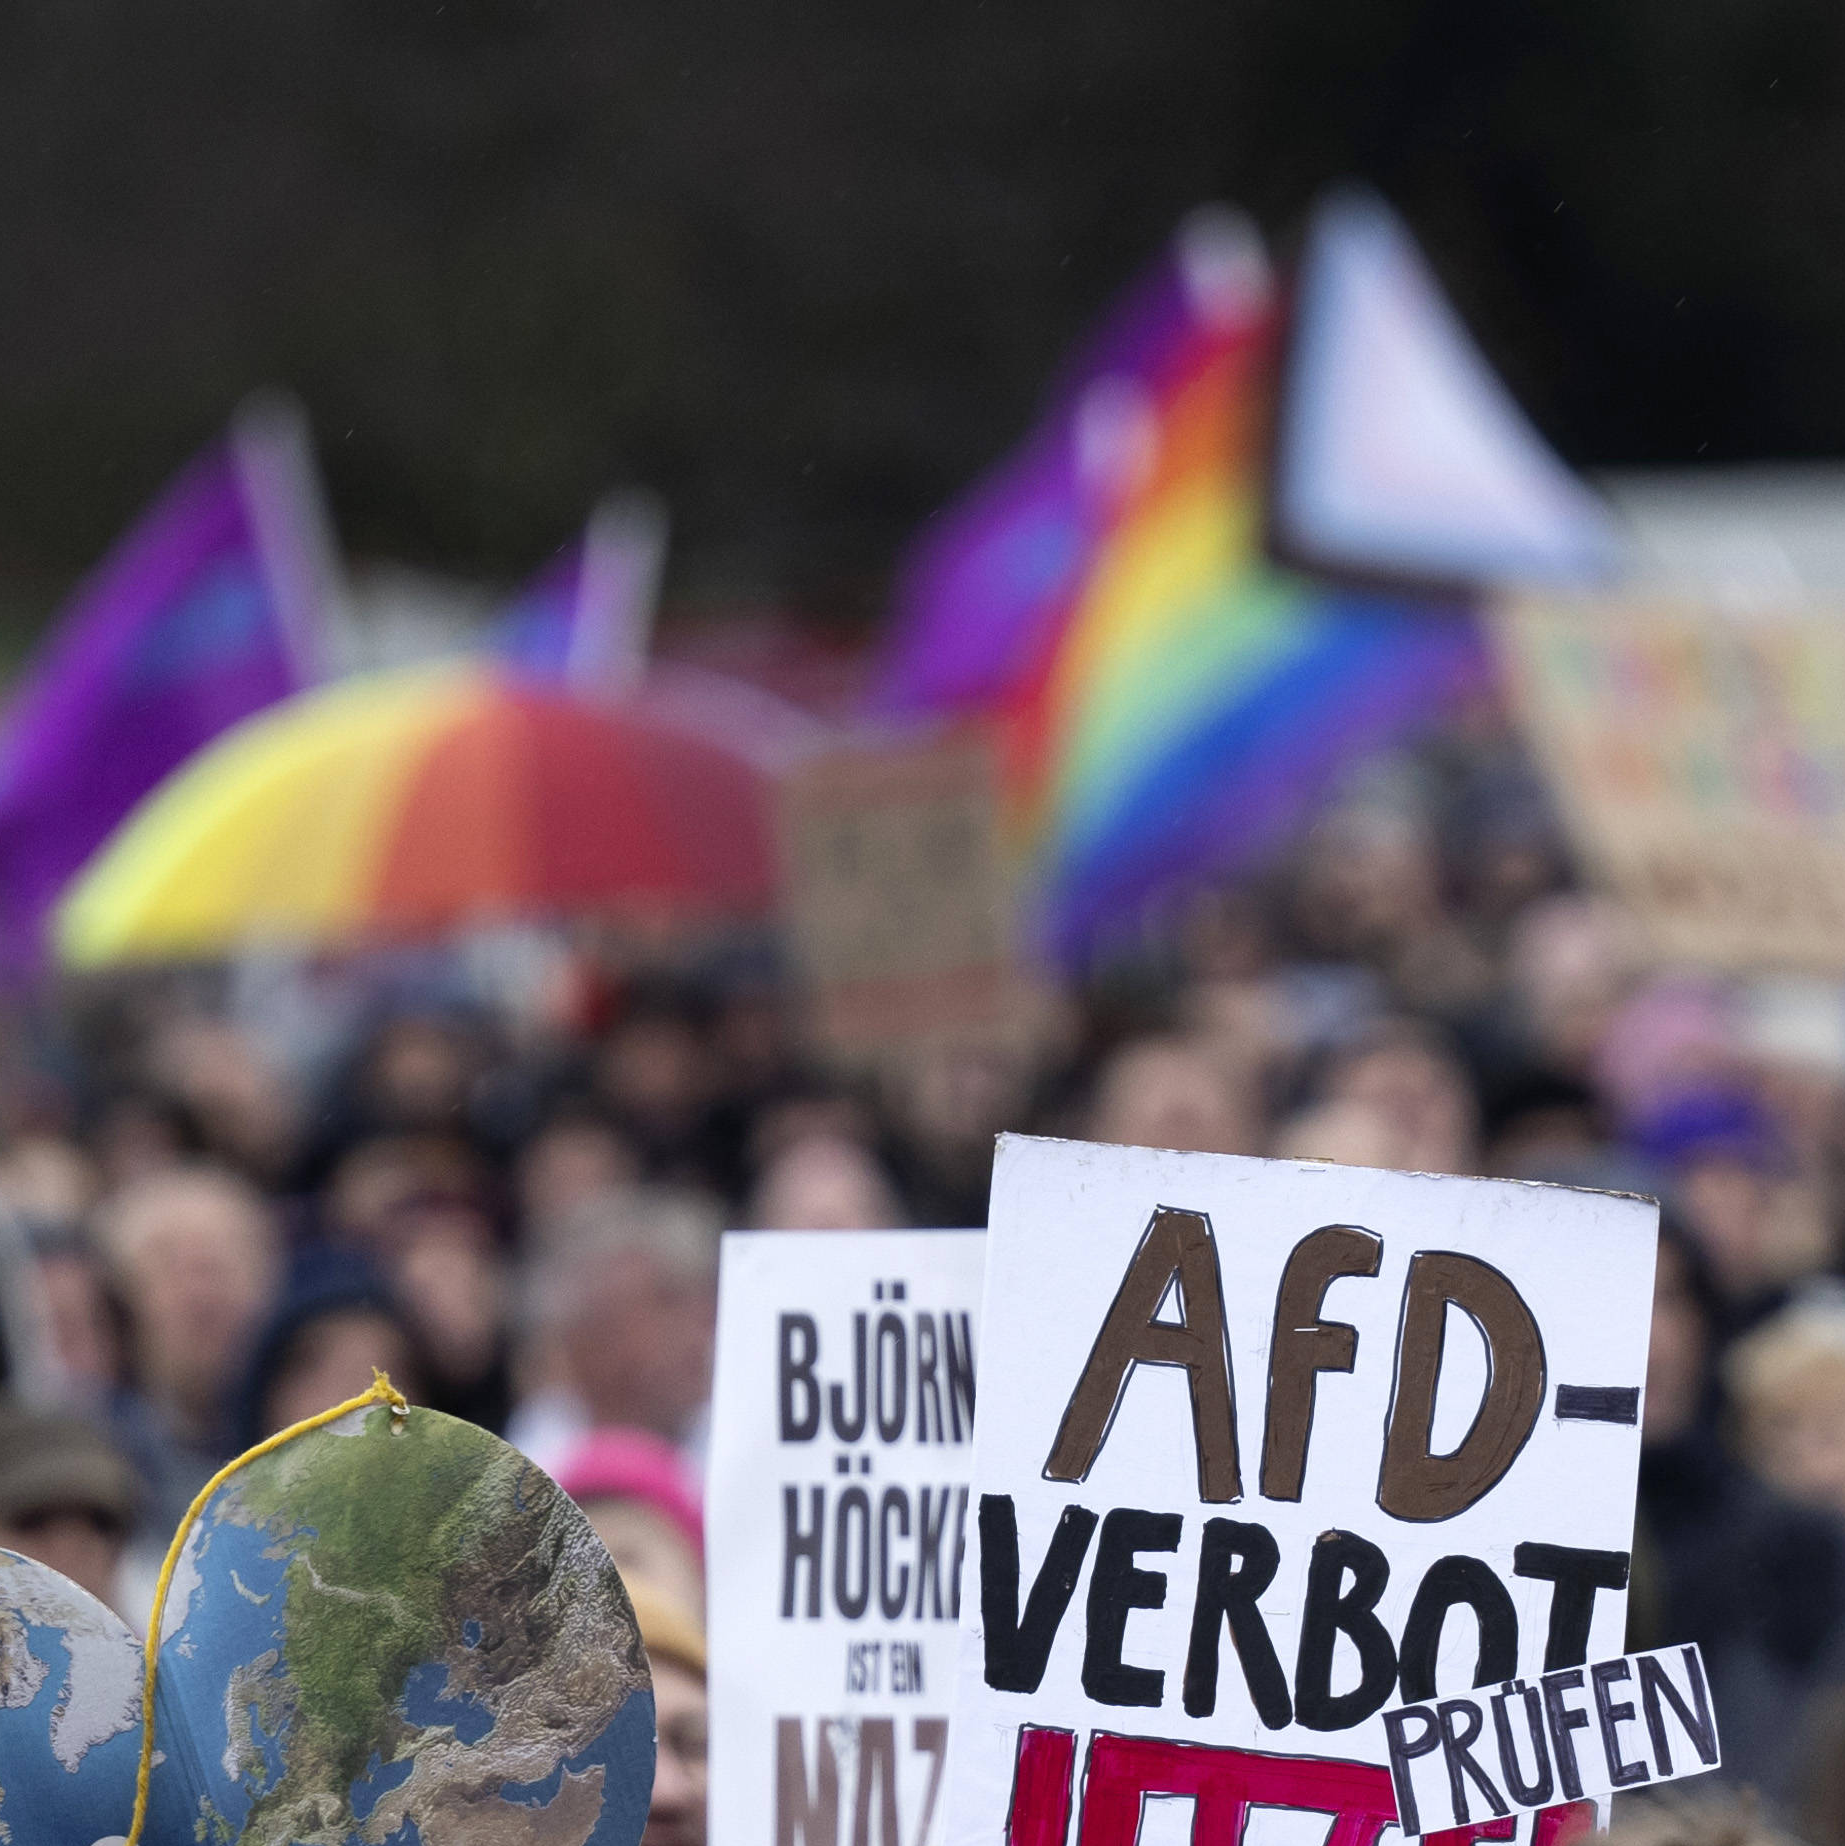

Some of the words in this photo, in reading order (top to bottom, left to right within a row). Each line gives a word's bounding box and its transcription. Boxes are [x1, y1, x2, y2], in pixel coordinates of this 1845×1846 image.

[778, 1280, 975, 1446] BJÖRN
[1041, 1204, 1640, 1524] AfD-
[846, 1641, 881, 1693] IST
[889, 1641, 925, 1694] EIN
[978, 1493, 1629, 1732] VERBOT
[1383, 1645, 1717, 1833] PRÜFEN
